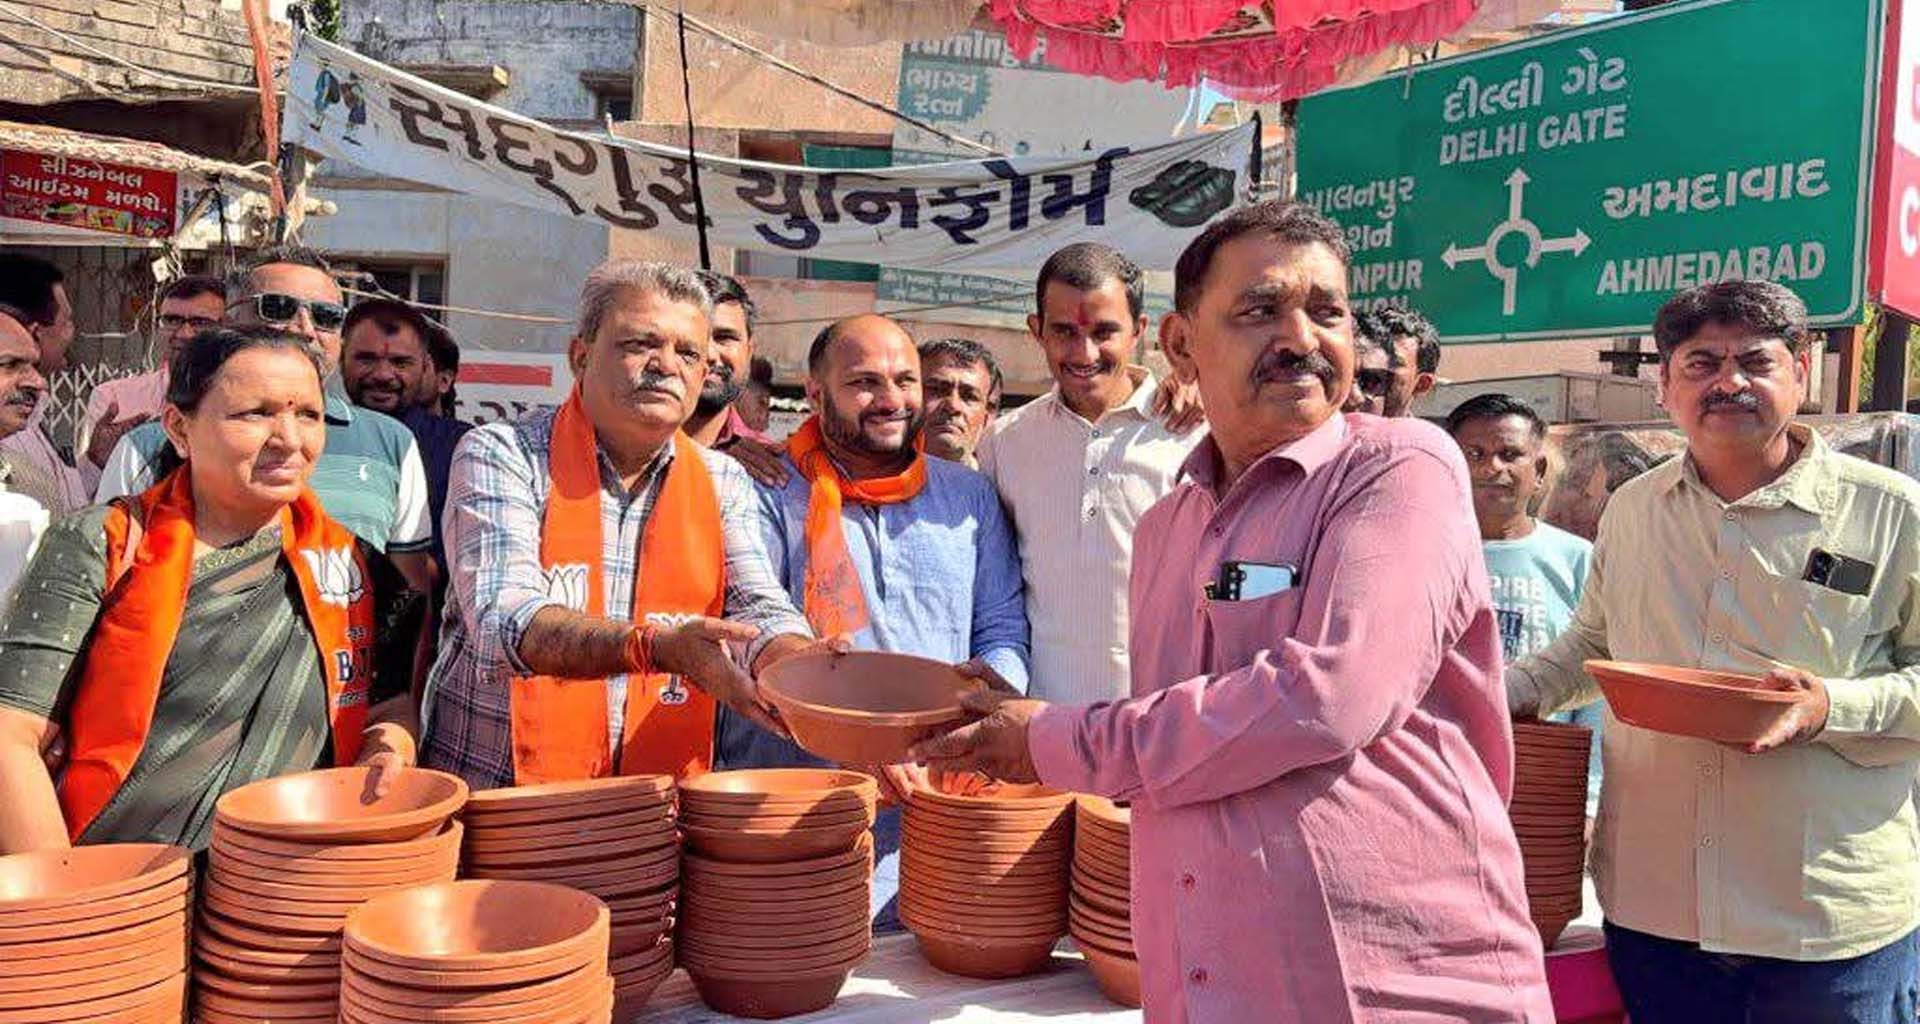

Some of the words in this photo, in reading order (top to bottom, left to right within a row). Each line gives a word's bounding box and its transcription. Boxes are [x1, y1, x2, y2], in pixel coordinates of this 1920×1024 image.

[1443, 61, 1544, 123] દીલ્લી
[1561, 47, 1628, 96] ગેટ
[1439, 122, 1528, 166] DELHI
[1537, 103, 1628, 150] GATE
[1602, 158, 1831, 219] અમદાવાદ
[1353, 259, 1424, 294] NPUR
[1596, 241, 1826, 295] AHMEDABAD
